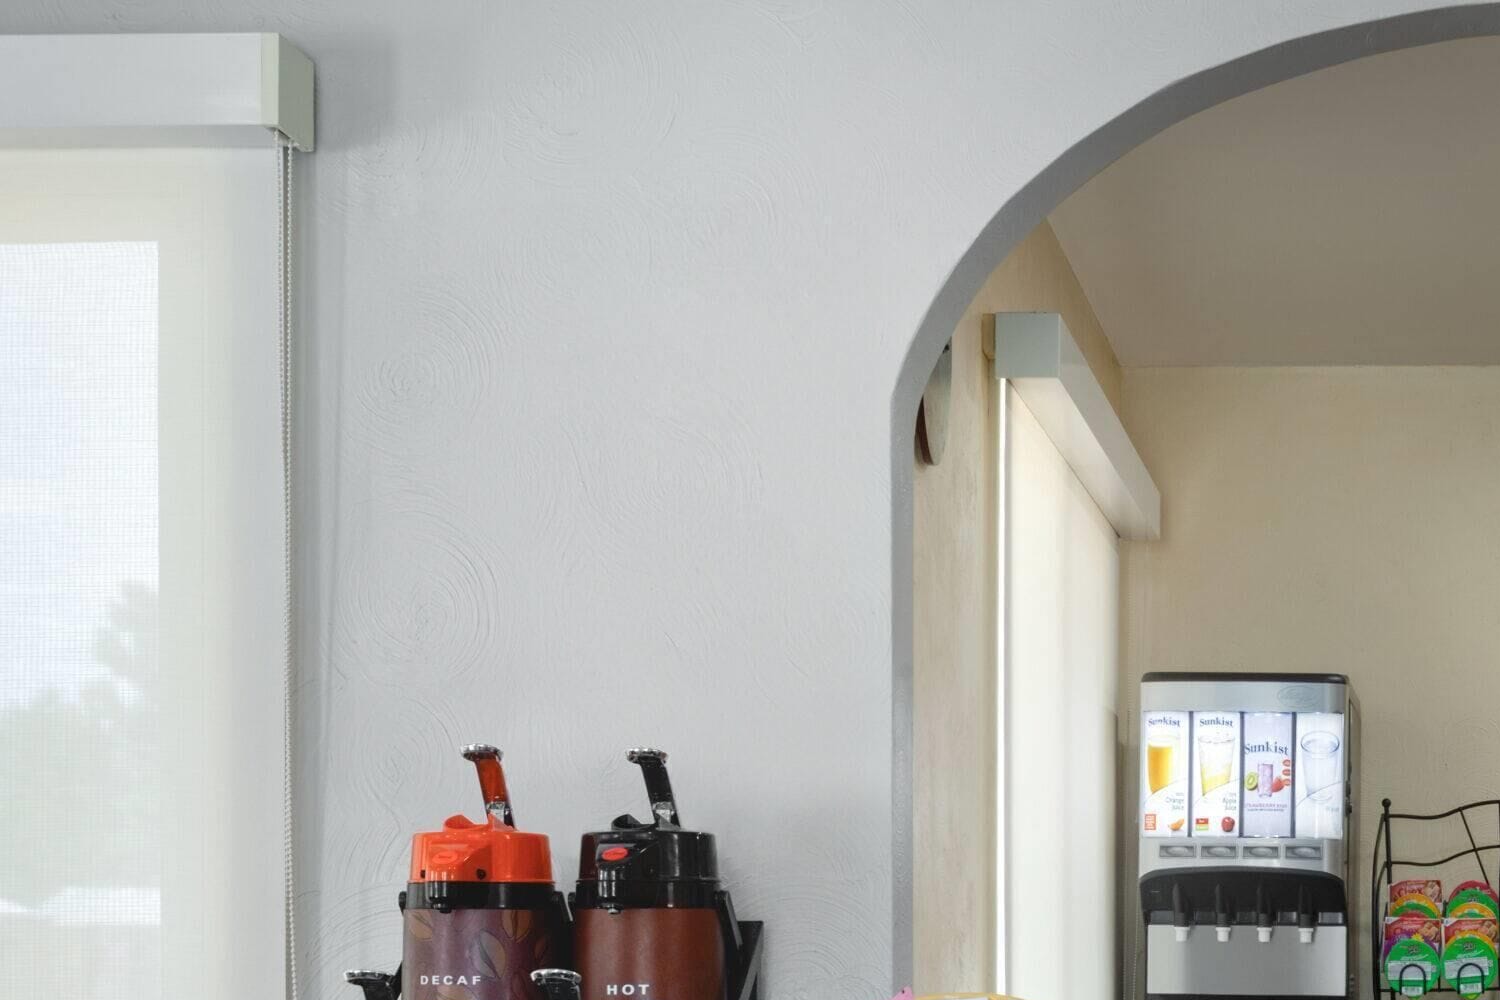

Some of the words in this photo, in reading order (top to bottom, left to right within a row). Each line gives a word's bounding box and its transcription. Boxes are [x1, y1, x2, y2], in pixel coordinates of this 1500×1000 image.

[1148, 716, 1181, 727] Sunkist
[1199, 716, 1234, 727] Sunkist
[1244, 741, 1288, 755] Sunkist
[420, 975, 481, 985] DECAF
[606, 984, 650, 996] HOT
